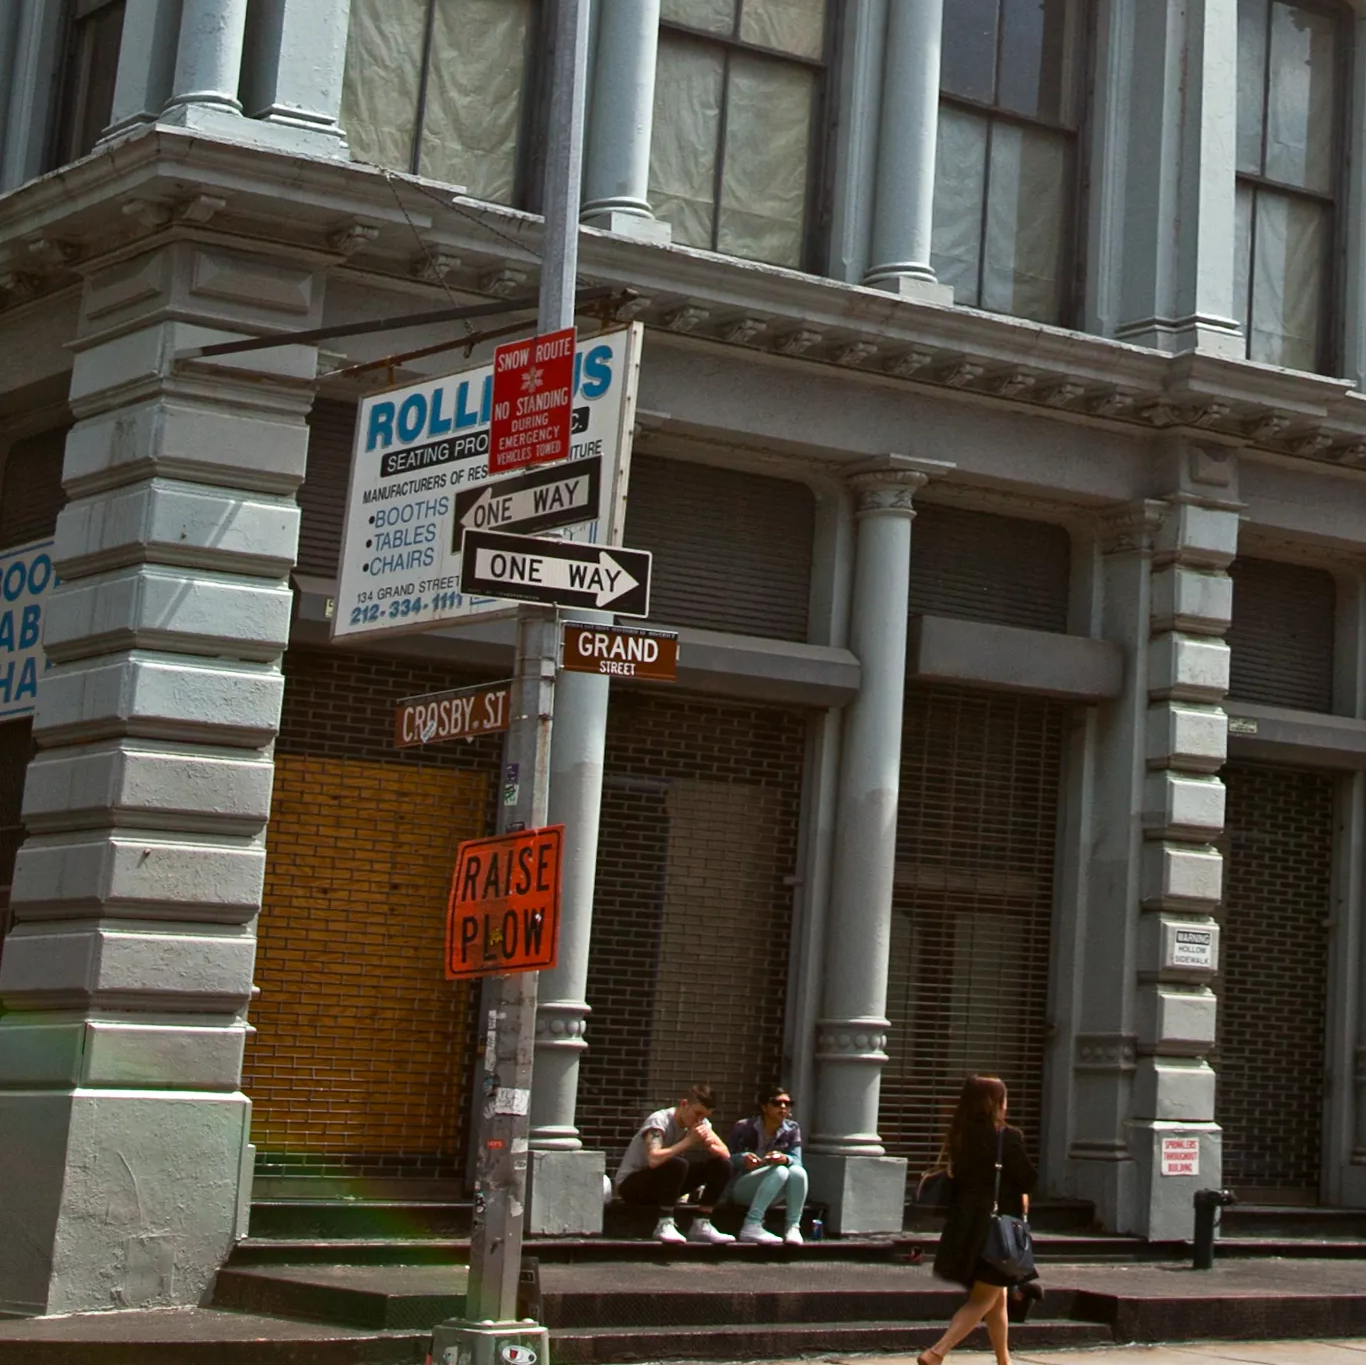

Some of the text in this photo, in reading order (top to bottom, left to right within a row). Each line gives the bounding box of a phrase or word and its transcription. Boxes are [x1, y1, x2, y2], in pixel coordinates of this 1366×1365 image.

[497, 337, 572, 373] SNOW ROUTE
[494, 387, 568, 421] NO STANDING
[499, 425, 560, 451] EMERGENCY
[511, 412, 549, 432] DURING
[387, 443, 449, 472] SEATING
[496, 440, 562, 465] VEHICLES TOWED
[362, 474, 447, 504] MANUFACTURERS
[450, 470, 464, 485] OF
[374, 495, 450, 529] BOOTHS
[473, 497, 513, 528] ONE
[533, 480, 580, 514] WAY
[374, 523, 437, 552] TABLES
[369, 547, 435, 576] CHAIRS
[490, 553, 622, 593] ONE WAY
[356, 575, 460, 604] 134 GRAND STREET
[578, 631, 660, 663] GRAND
[599, 660, 637, 677] STREET
[484, 690, 507, 730] ST
[461, 843, 553, 902] RAISE
[460, 906, 546, 964] PLOW
